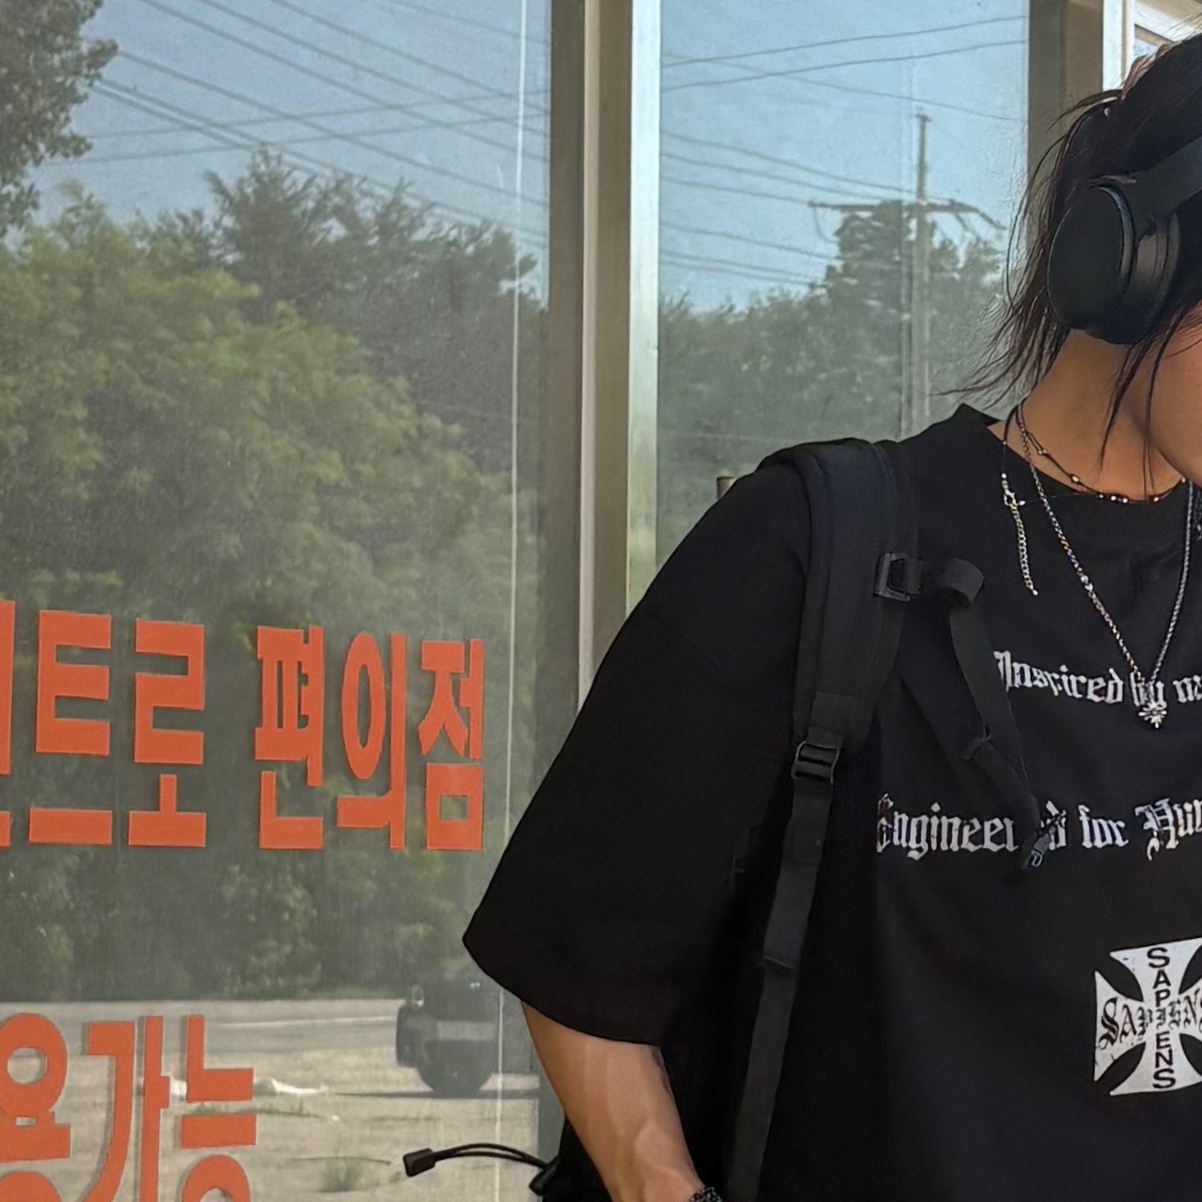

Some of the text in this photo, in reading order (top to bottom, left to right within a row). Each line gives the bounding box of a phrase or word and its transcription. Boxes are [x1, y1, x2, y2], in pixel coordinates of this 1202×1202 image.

[994, 650, 1123, 704] Inspired
[254, 625, 486, 850] 편의점
[876, 793, 1067, 860] Engineerd
[1078, 804, 1129, 849] for
